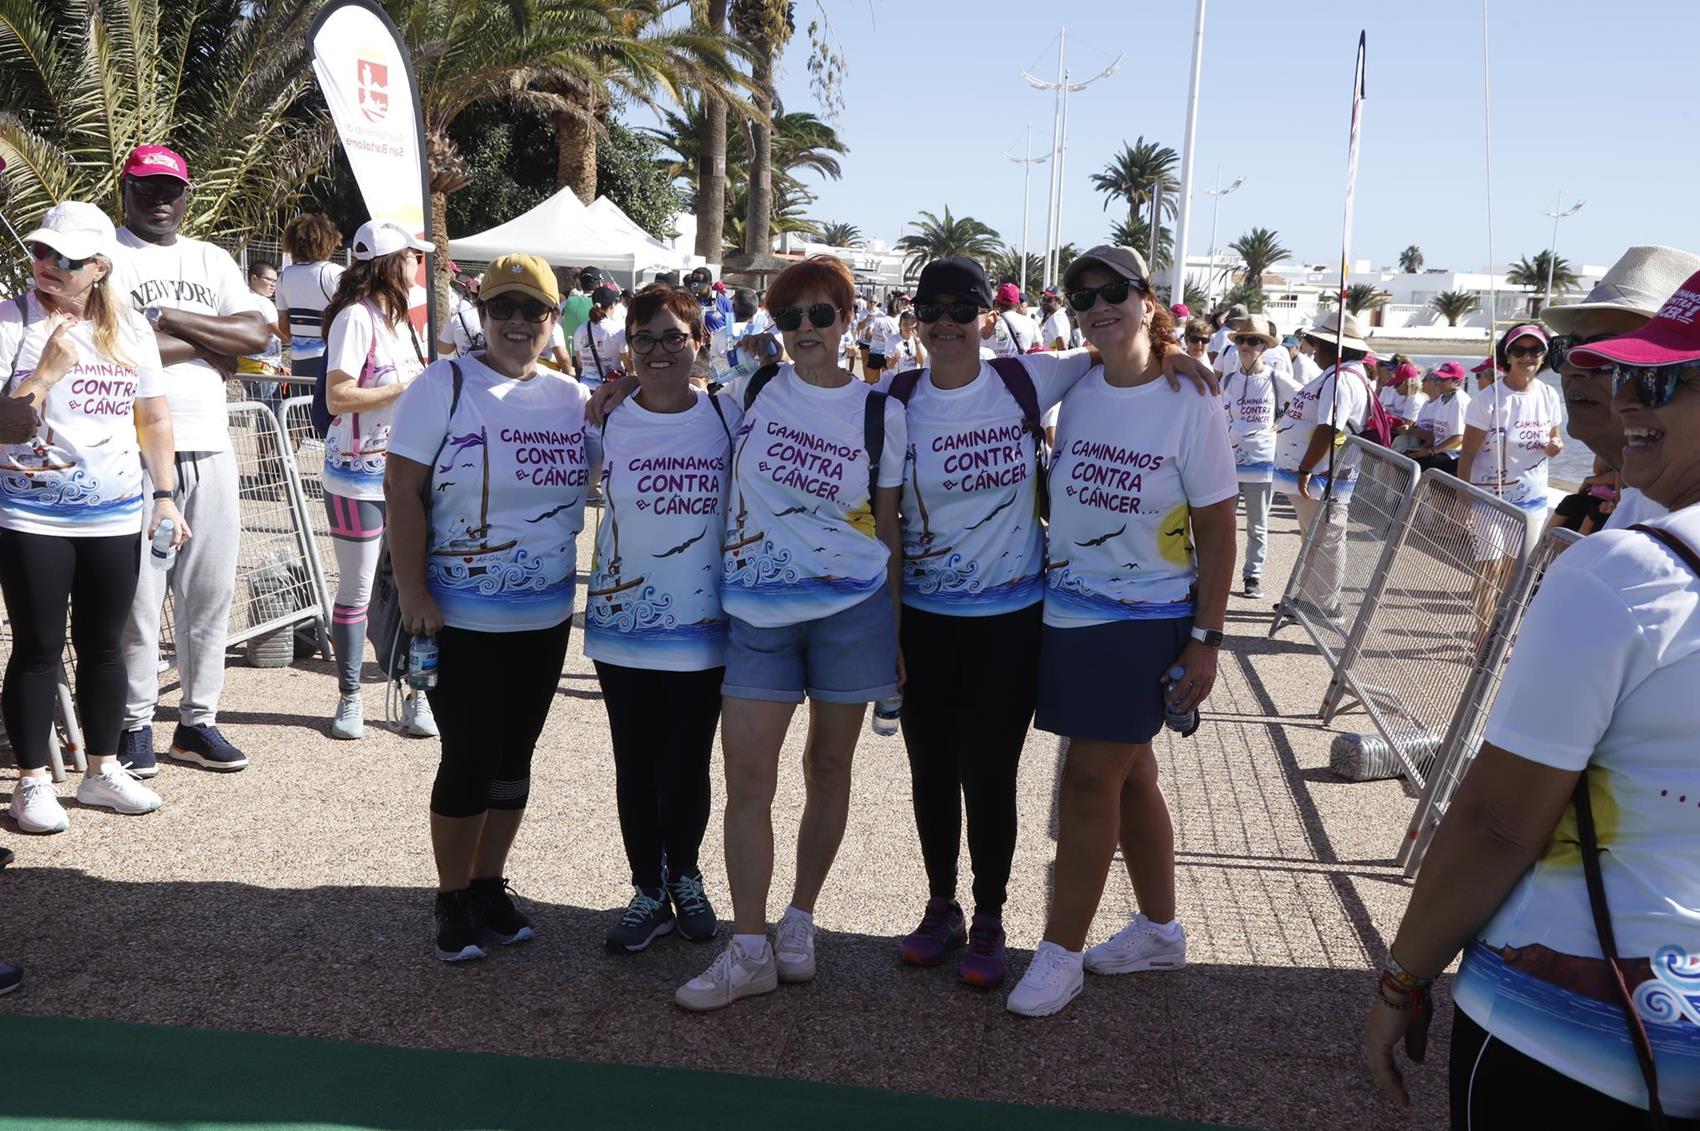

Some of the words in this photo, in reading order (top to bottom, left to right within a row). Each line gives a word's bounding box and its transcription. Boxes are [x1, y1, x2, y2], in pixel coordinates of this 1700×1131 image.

[130, 279, 172, 307] NEW
[169, 280, 218, 309] YORK
[68, 400, 81, 410] EL
[767, 421, 862, 462] CAMINAMOS
[628, 456, 724, 471] CAMINAMOS
[767, 442, 843, 480] CONTRA
[944, 442, 1024, 474] CONTRA
[1071, 440, 1164, 471] CAMINAMOS
[515, 469, 530, 481] EL
[759, 461, 772, 472] EL
[637, 474, 720, 494] CONTRA
[942, 479, 958, 491] EL
[1071, 461, 1142, 493] CONTRA
[1066, 485, 1078, 497] EL
[636, 499, 651, 511] EL
